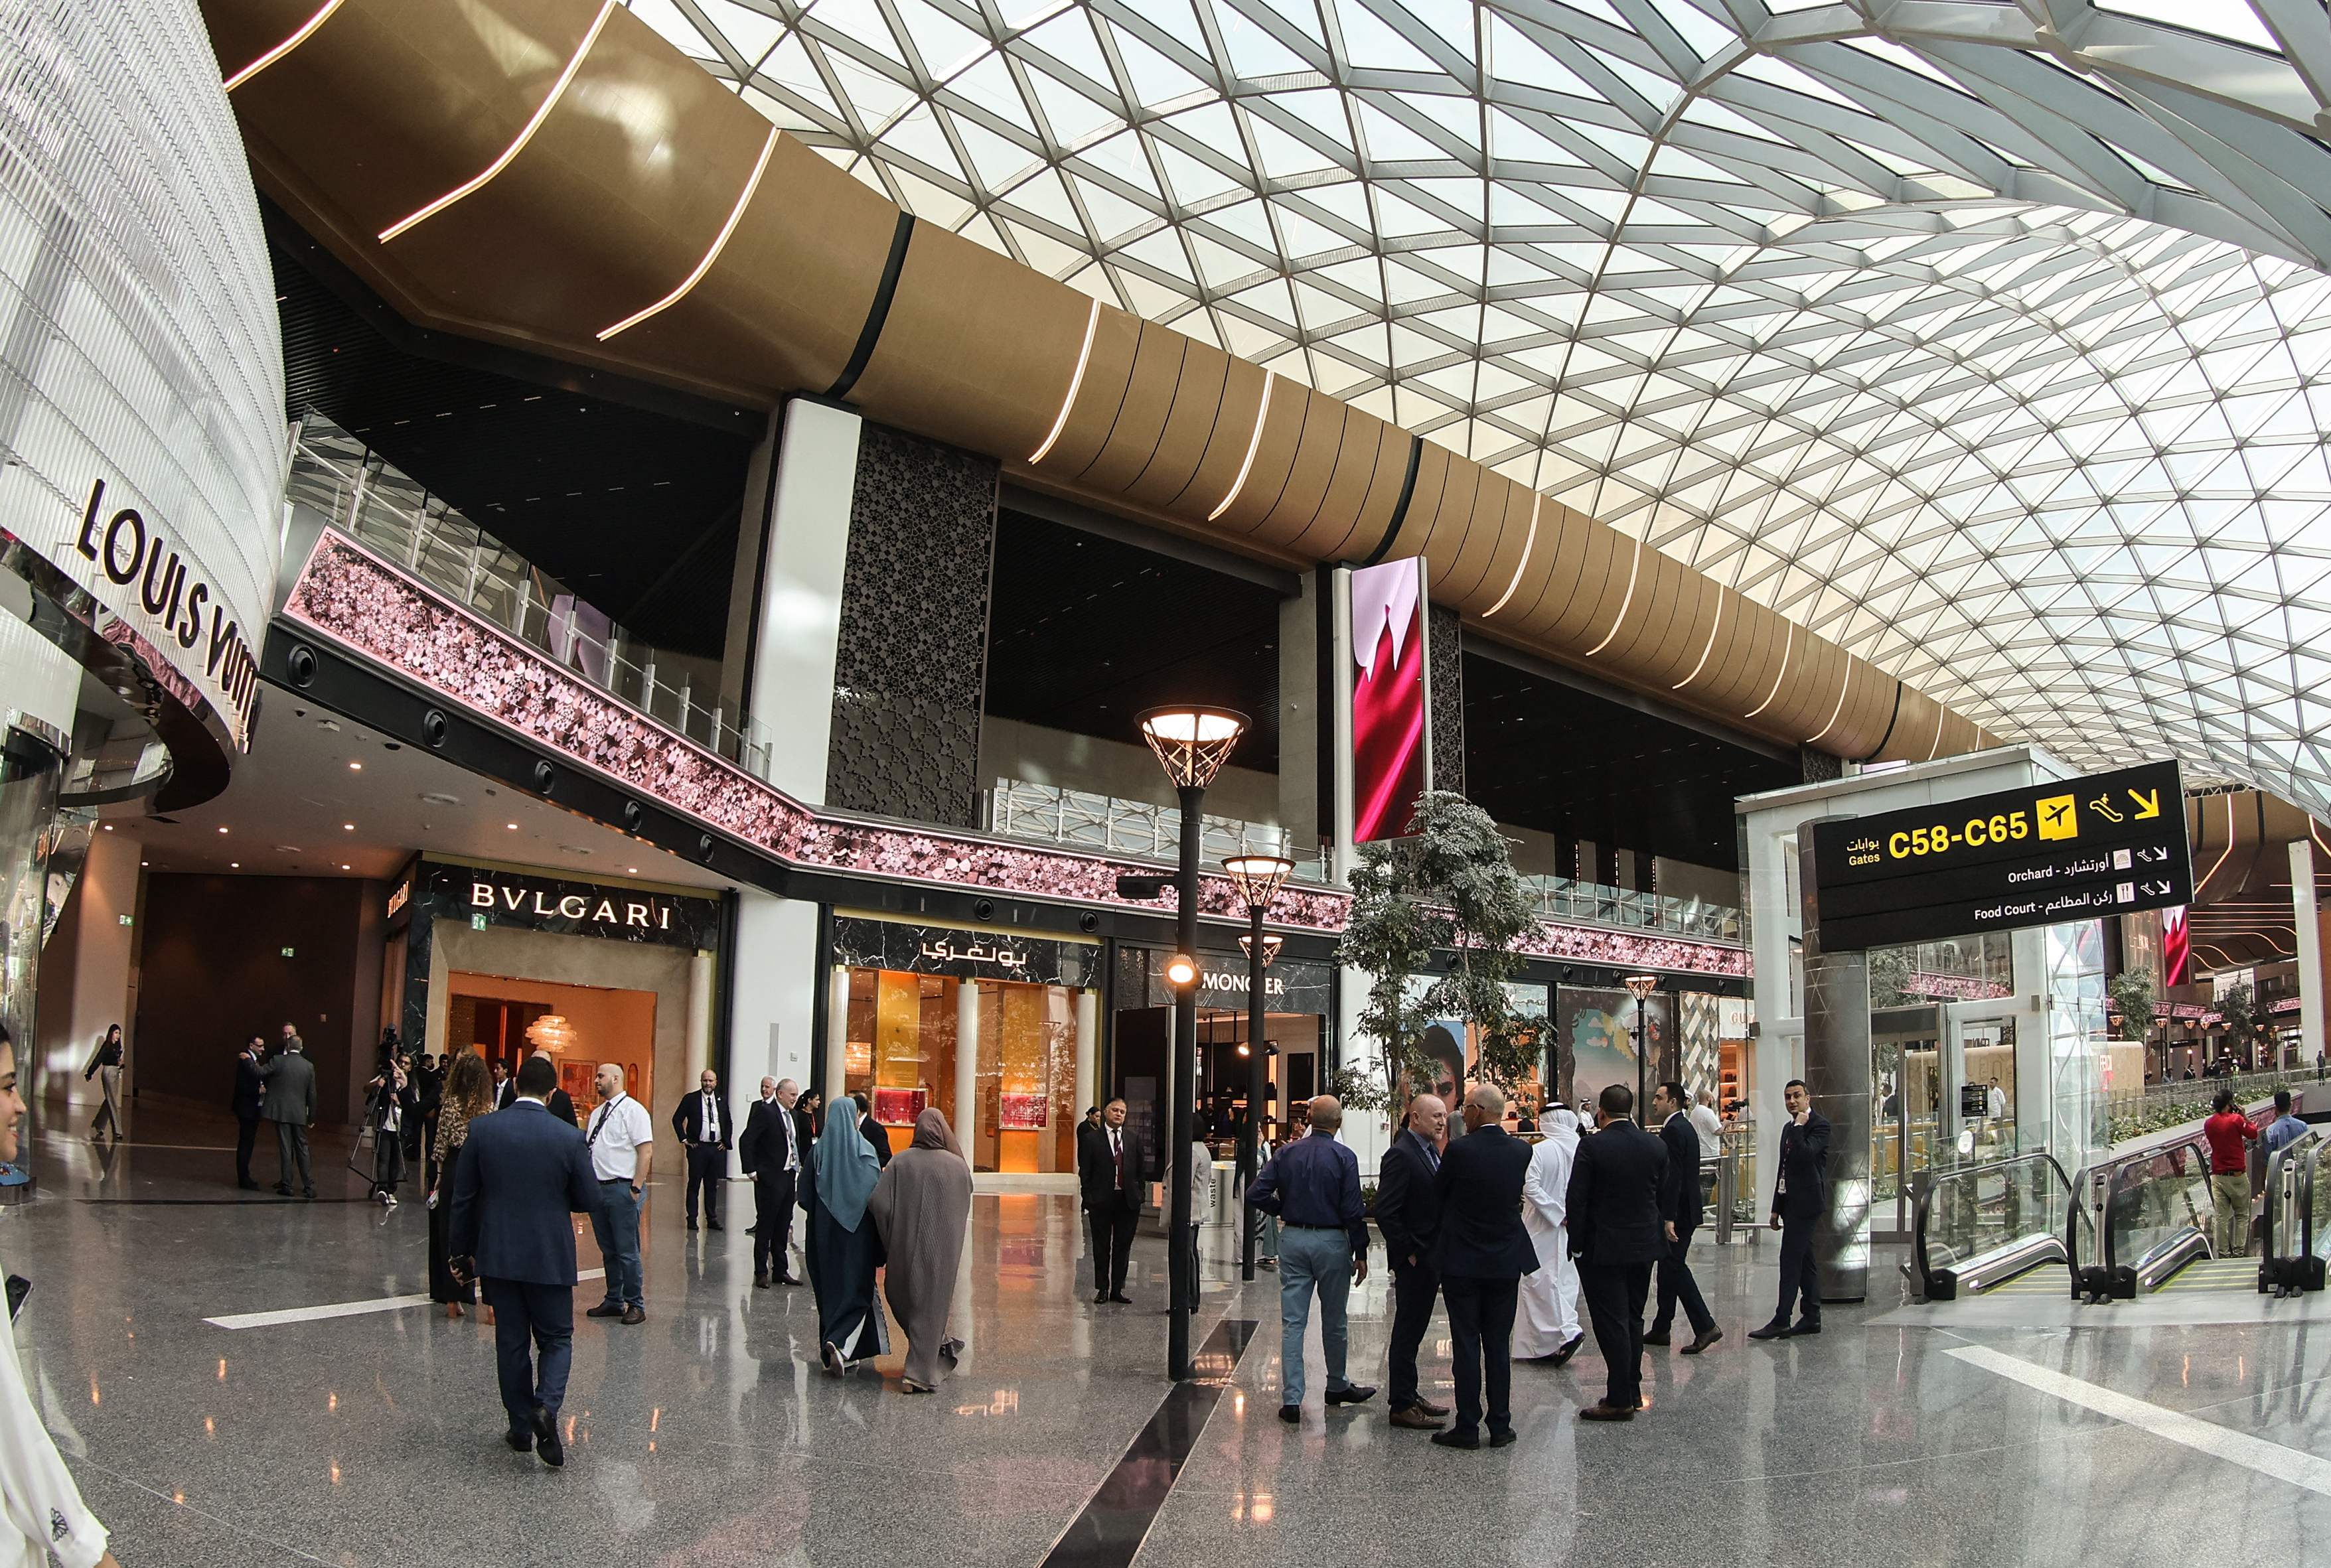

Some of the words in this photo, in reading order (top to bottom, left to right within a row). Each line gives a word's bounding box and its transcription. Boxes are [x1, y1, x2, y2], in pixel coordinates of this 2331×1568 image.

[74, 478, 208, 649] LOUIS
[1846, 837, 1880, 851] بوابات
[1889, 811, 2028, 859] C58-C65
[1848, 853, 1880, 866] Gates
[2008, 865, 2053, 883] Orchard
[2064, 853, 2109, 876] أورتشارد
[471, 883, 670, 930] BVLGARI
[2004, 901, 2036, 915] Court
[2045, 892, 2089, 915] المطاعم
[2093, 890, 2113, 906] ركن
[1975, 902, 2001, 920] Food
[922, 942, 1026, 967] بولغري
[1201, 972, 1284, 995] MONCER
